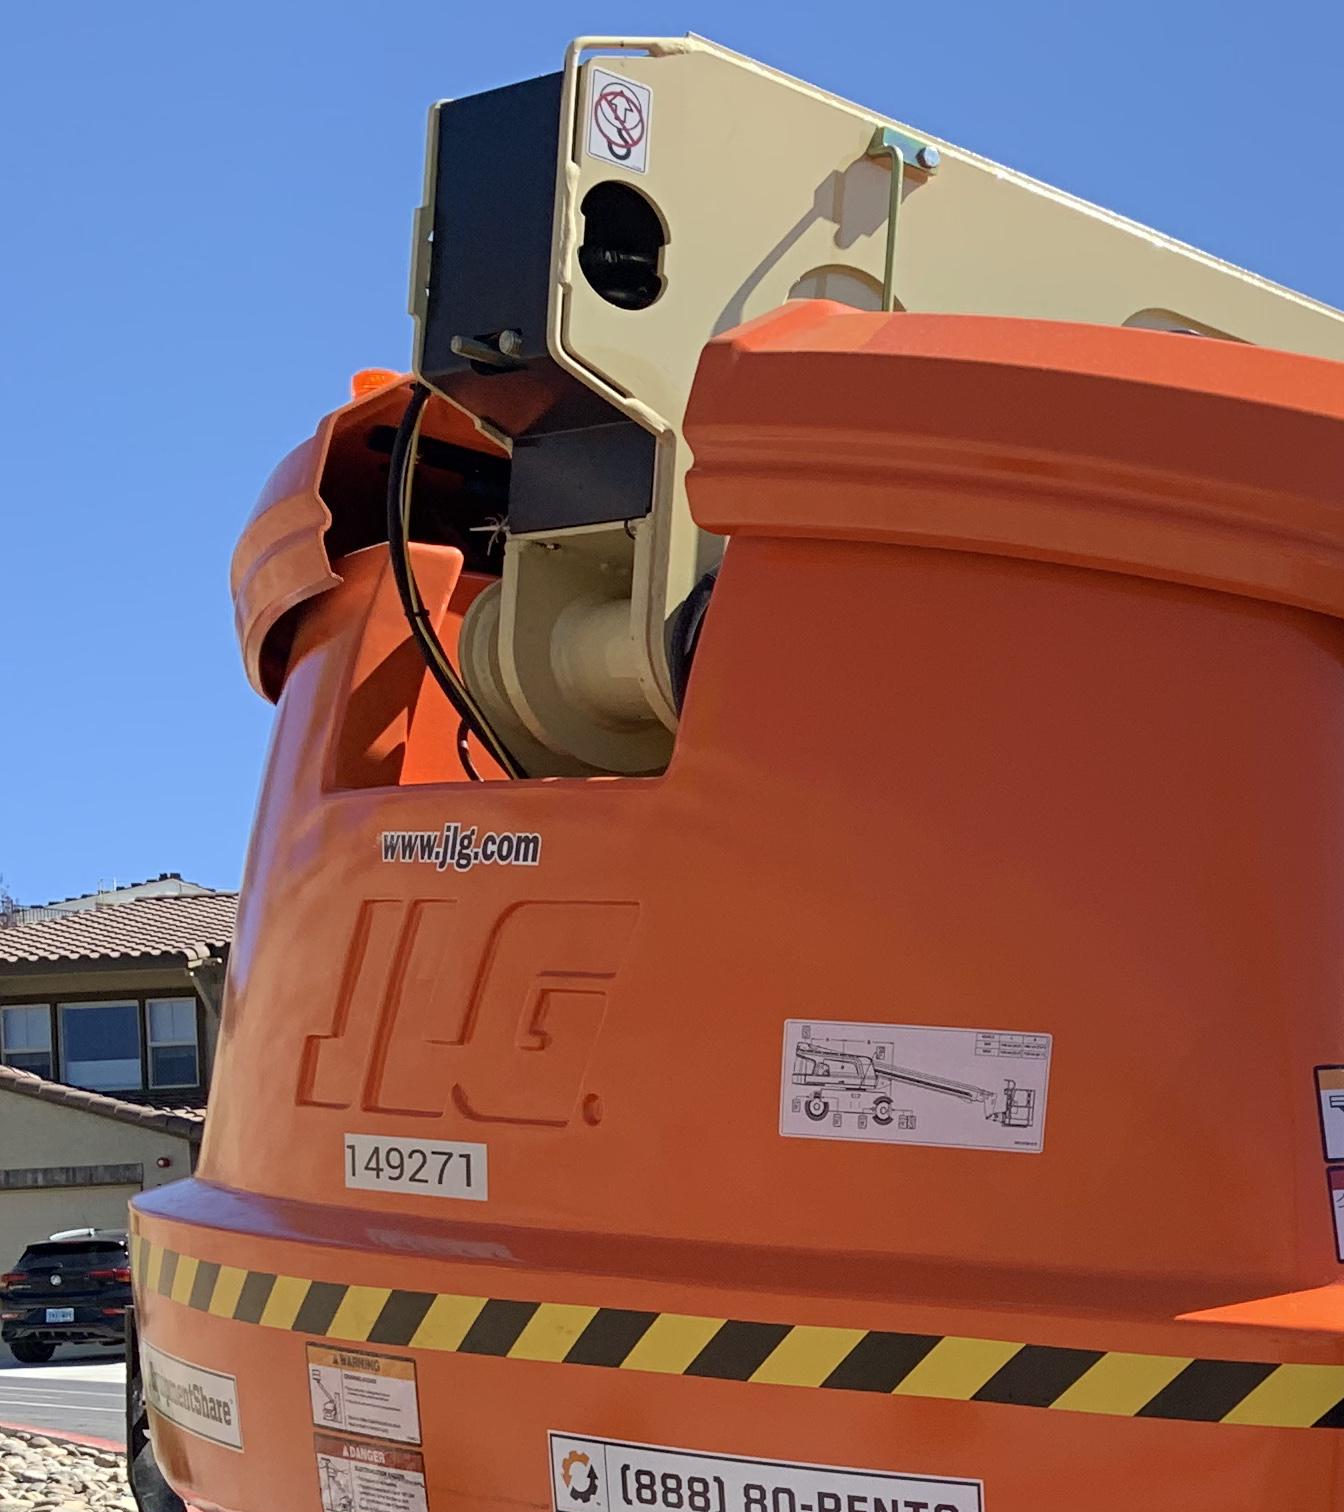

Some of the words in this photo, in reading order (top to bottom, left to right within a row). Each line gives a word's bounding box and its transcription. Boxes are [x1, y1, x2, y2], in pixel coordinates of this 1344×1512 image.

[382, 826, 539, 868] www.jlg.com
[347, 1144, 474, 1188] 149271
[340, 1356, 380, 1372] WARNING
[351, 1448, 386, 1464] DANGER
